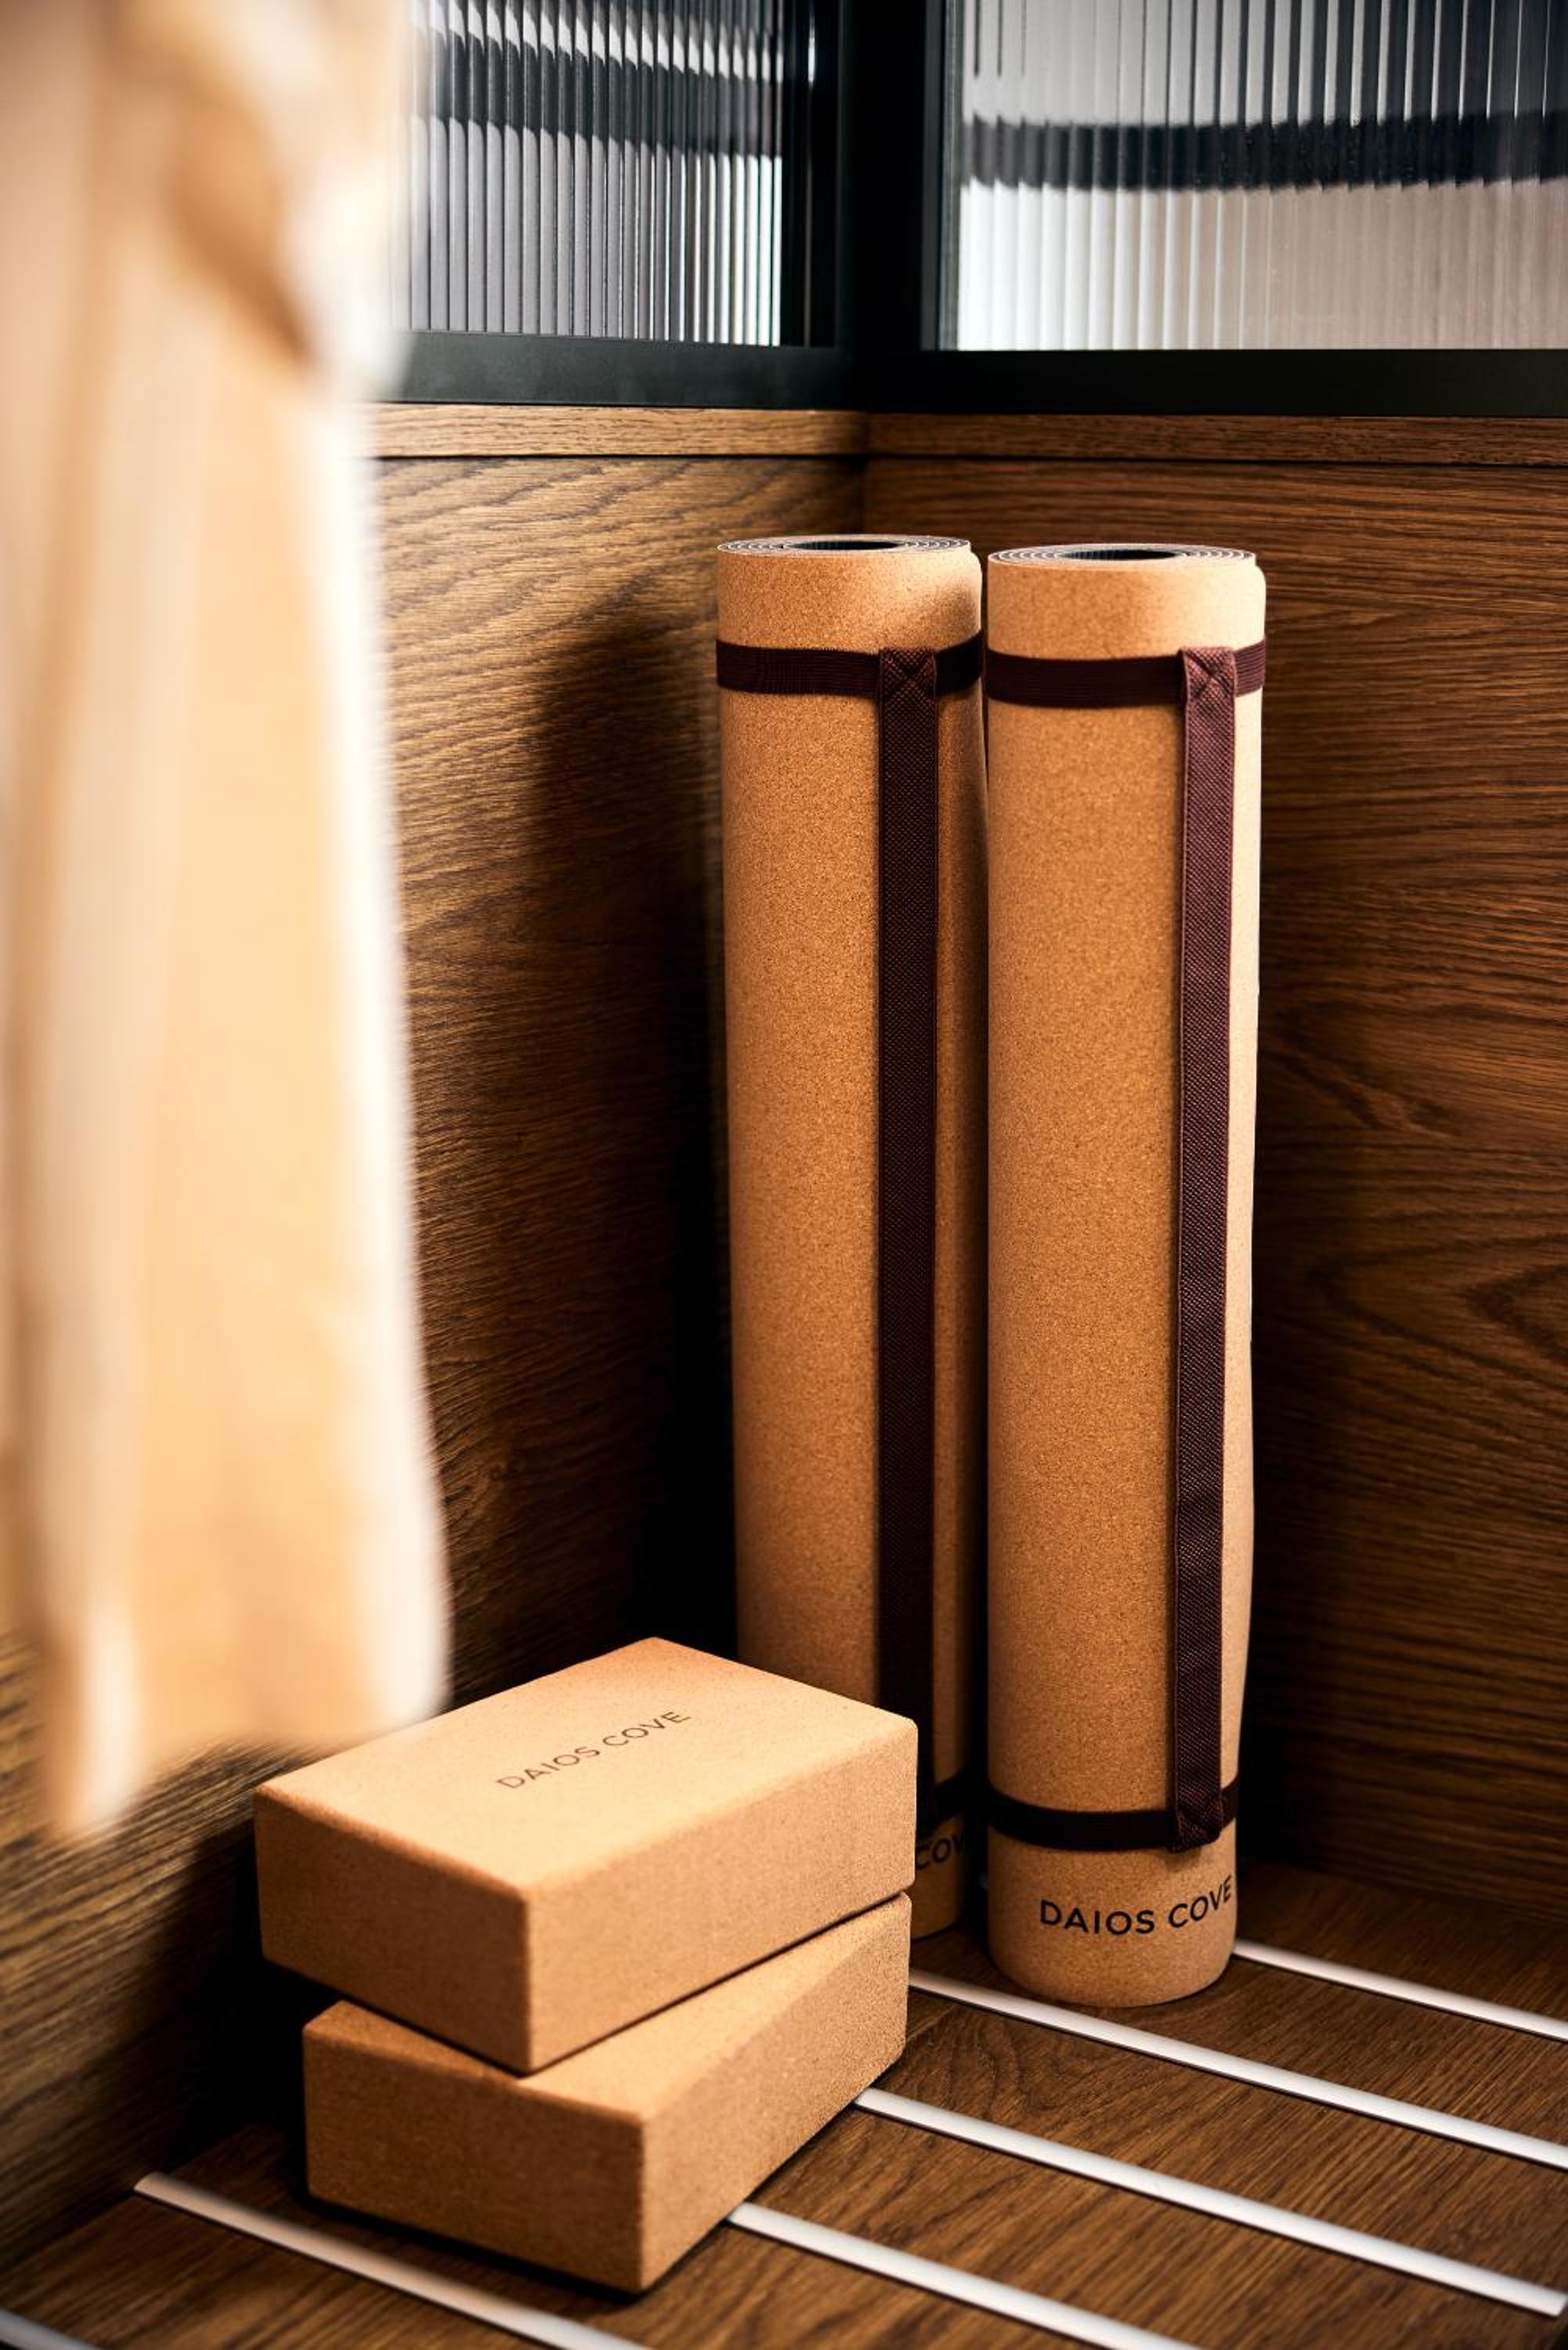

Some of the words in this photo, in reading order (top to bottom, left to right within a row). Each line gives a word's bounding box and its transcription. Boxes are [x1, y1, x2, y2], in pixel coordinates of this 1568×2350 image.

[496, 1746, 601, 1789] DAIOS
[602, 1712, 691, 1747] COVE
[1040, 1900, 1154, 1936] DAIOS
[1168, 1875, 1232, 1929] COVE
